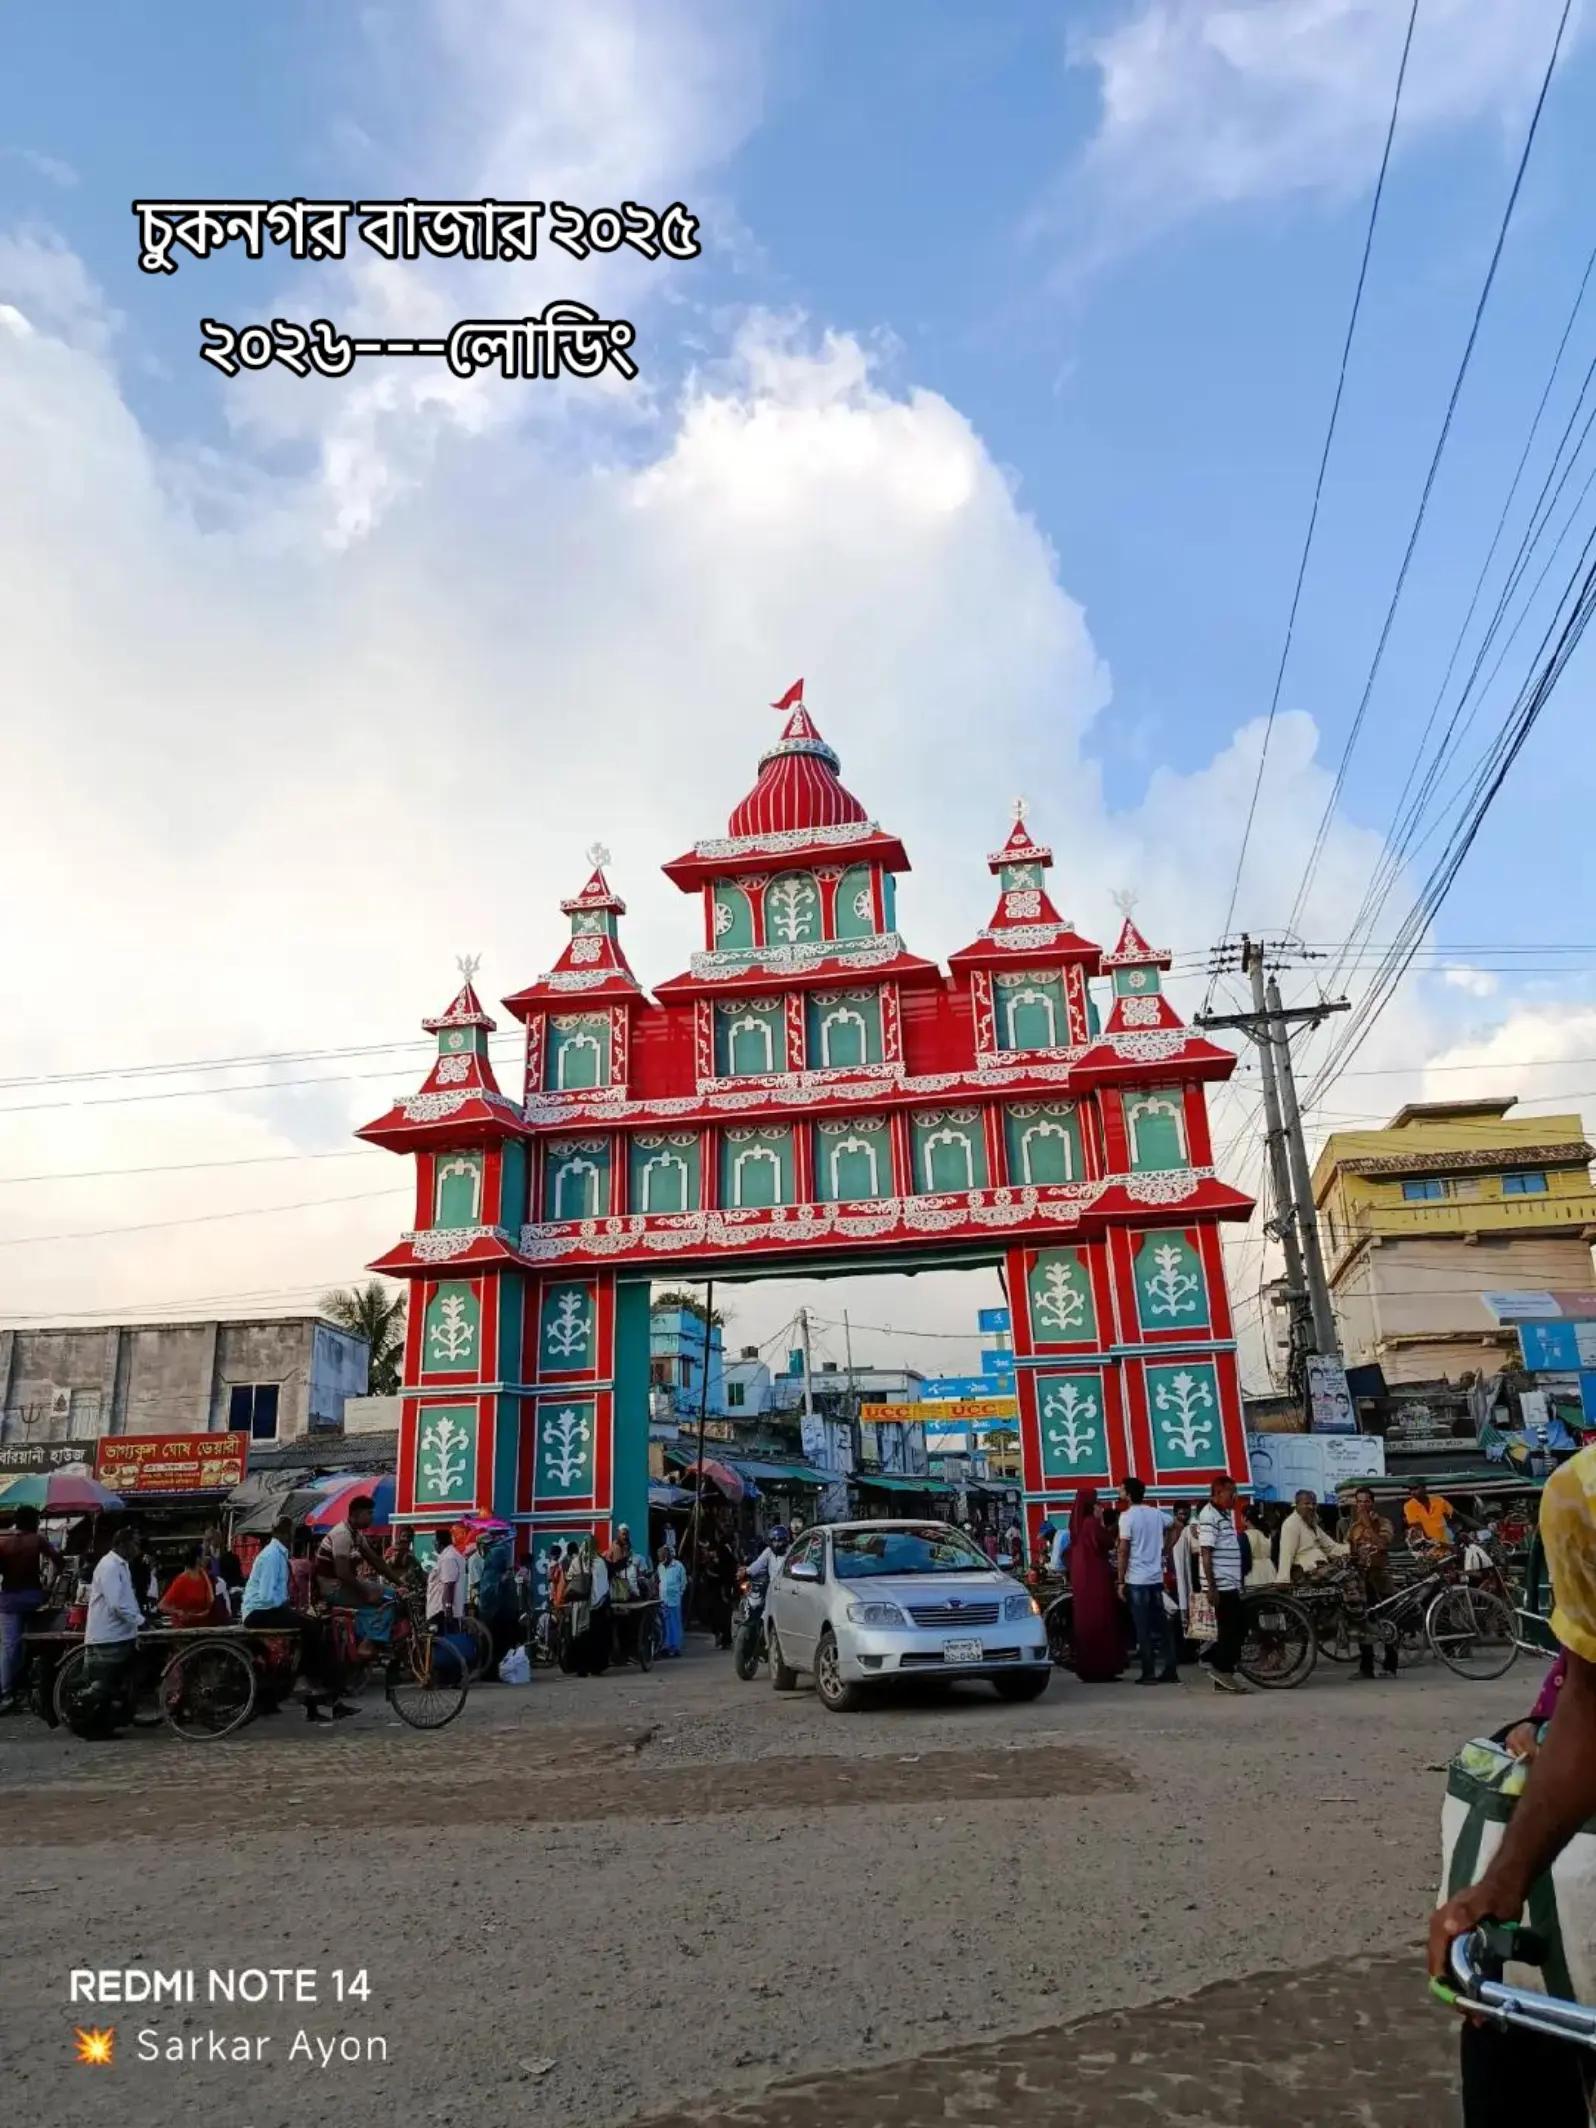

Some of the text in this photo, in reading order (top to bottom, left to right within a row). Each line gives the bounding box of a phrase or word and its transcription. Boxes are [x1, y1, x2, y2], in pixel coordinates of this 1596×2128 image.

[864, 1407, 909, 1418] UCC
[951, 1404, 997, 1415] UCC
[162, 1442, 192, 1457] ঘোষ
